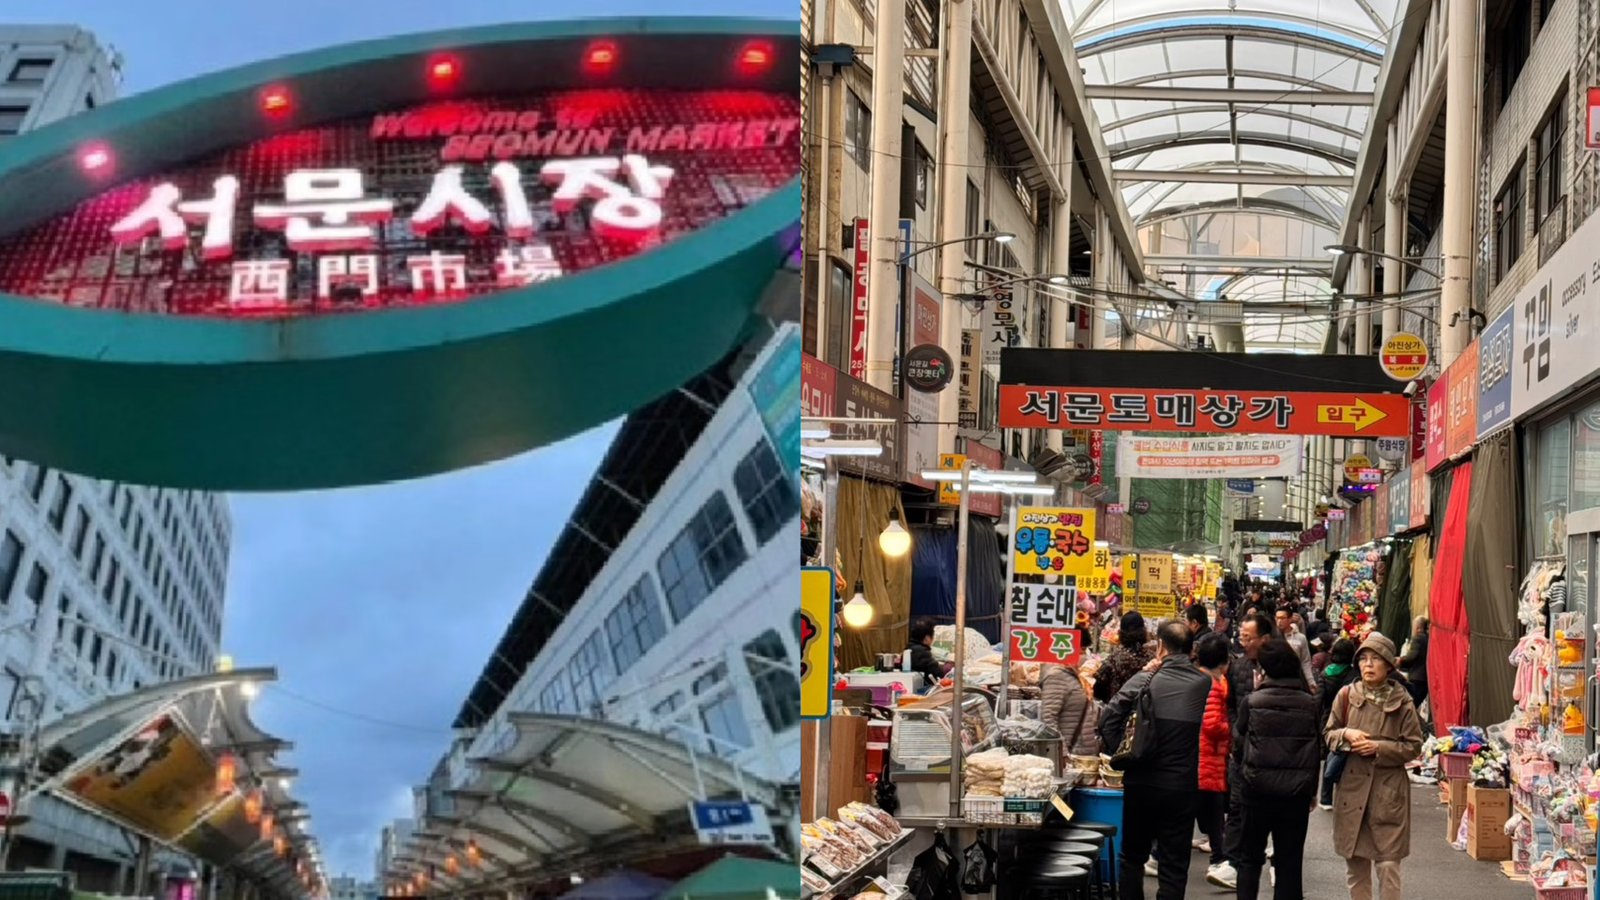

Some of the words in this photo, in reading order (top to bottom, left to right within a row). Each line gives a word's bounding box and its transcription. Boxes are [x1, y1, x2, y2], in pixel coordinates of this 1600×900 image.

[626, 117, 798, 151] MARKET
[110, 154, 675, 258] 서문시장
[231, 245, 564, 309] 西門市場
[1388, 341, 1420, 350] 아진상가
[1018, 391, 1294, 429] 서문도매상가
[1326, 408, 1368, 421] 입구
[1378, 440, 1405, 451] 주원식당
[1148, 567, 1160, 580] 떡
